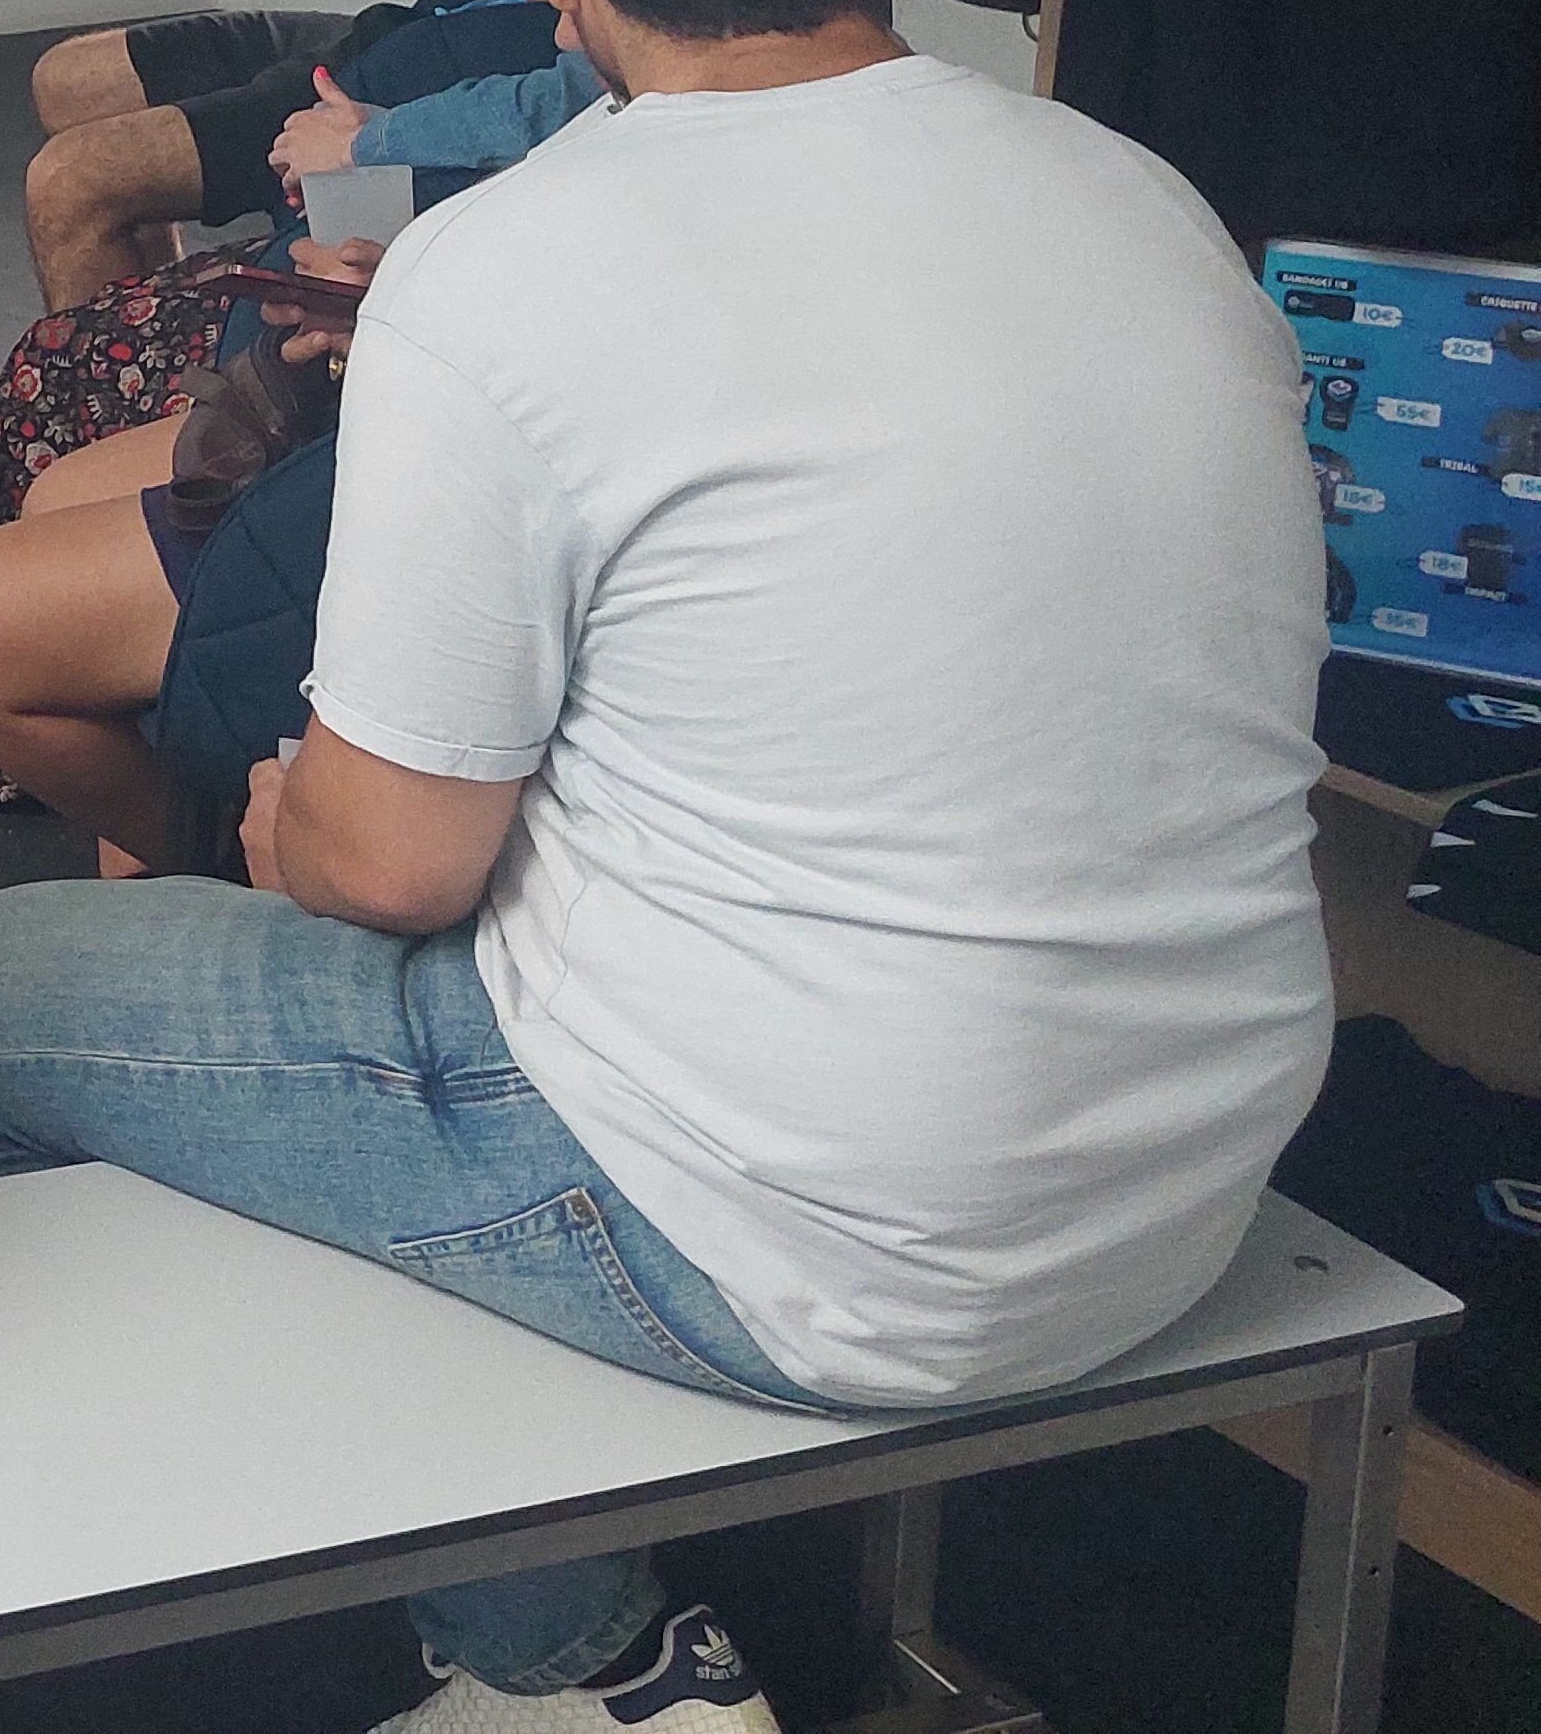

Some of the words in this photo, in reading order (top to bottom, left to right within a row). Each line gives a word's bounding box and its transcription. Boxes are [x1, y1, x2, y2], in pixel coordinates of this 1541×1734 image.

[1363, 306, 1394, 321] 10€
[1450, 341, 1487, 358] 20€
[1440, 458, 1477, 474] TRIBAL
